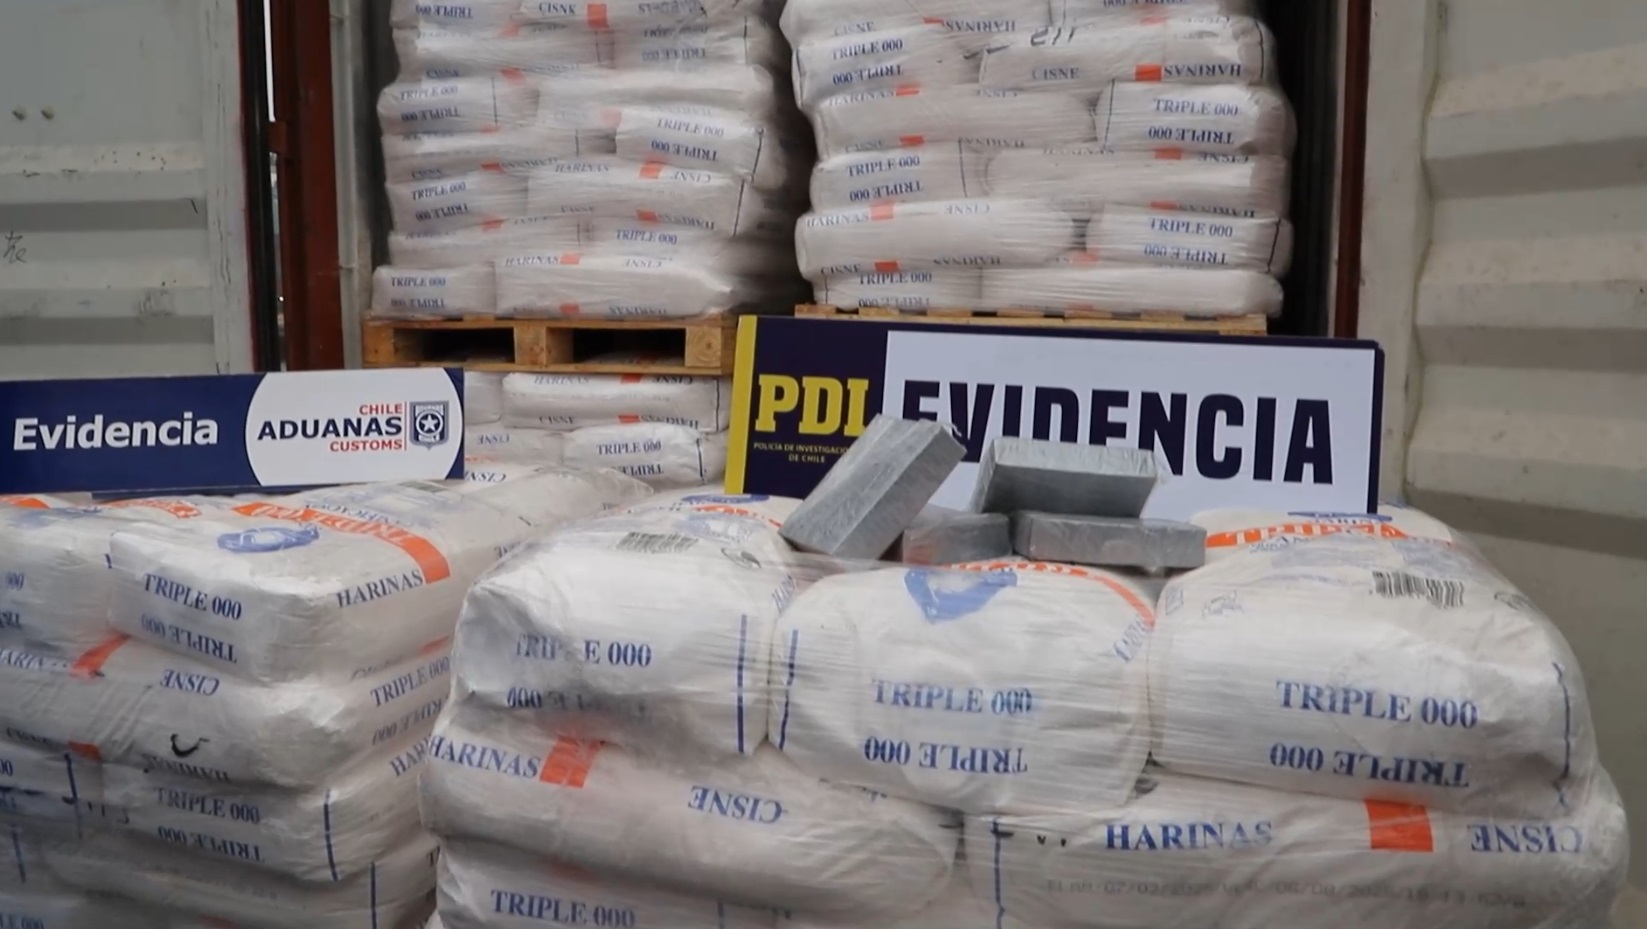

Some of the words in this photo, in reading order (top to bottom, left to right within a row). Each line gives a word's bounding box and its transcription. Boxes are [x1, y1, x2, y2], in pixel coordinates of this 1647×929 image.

[832, 43, 880, 60] TRIPLE
[882, 39, 903, 51] 000
[832, 74, 853, 86] 000
[856, 64, 905, 82] TRIPLE
[1164, 64, 1241, 77] HARINAS
[1153, 99, 1210, 114] TRIPLE
[1214, 102, 1239, 116] 000
[657, 117, 701, 134] TRIPLE
[703, 126, 725, 138] 000
[1149, 127, 1173, 140] 000
[1175, 128, 1235, 145] TRIPLE
[651, 140, 670, 154] 000
[672, 144, 719, 162] TRIPLE
[846, 159, 895, 177] TRIPLE
[899, 155, 920, 168] 000
[411, 187, 448, 201] TRIPLE
[848, 189, 870, 201] 000
[872, 180, 923, 199] TRIPLE
[616, 228, 656, 243] TRIPLE
[658, 233, 678, 245] 000
[1149, 217, 1206, 235] TRIPLE
[1208, 223, 1234, 239] 000
[1143, 244, 1167, 257] 000
[1170, 250, 1229, 266] TRIPLE
[391, 276, 427, 288] TRIPLE
[428, 277, 446, 288] 000
[858, 272, 909, 286] TRIPLE
[911, 270, 932, 284] 000
[359, 403, 403, 416] CHILE
[755, 374, 869, 437] PDI
[13, 411, 219, 450] Evidencia
[257, 416, 403, 441] ADUANAS
[329, 439, 403, 452] CUSTOMS
[596, 443, 642, 456] TRIPLE
[784, 444, 795, 452] DE
[788, 454, 799, 462] DE
[802, 455, 826, 463] CHILE
[464, 470, 507, 483] CISN
[143, 573, 208, 612] TRIPLE
[212, 596, 242, 621] 000
[335, 569, 425, 608] HARINAS
[140, 612, 166, 635] 000
[168, 623, 238, 664] TRIPLE
[606, 640, 653, 668] 000
[160, 668, 220, 697] CISNE
[369, 668, 428, 708] TRIPLE
[428, 656, 451, 680] 000
[506, 686, 543, 710] 000
[871, 678, 984, 713] TRIPLE
[990, 686, 1034, 716] 000
[1275, 680, 1412, 722] TRIPLE
[1420, 696, 1479, 729] 000
[371, 722, 399, 746] 000
[429, 734, 543, 779] HARINAS
[863, 735, 912, 766] 000
[918, 742, 1028, 774] TRIPLE
[1269, 742, 1324, 772] 000
[1332, 749, 1470, 789] TRIPLE
[154, 786, 226, 818] TRIPLE
[229, 805, 261, 826] 000
[687, 784, 784, 825] CISNE
[157, 825, 188, 846] 000
[1104, 820, 1273, 851] HARINAS
[1467, 824, 1583, 854] CISNE
[190, 832, 266, 864] TRIPLE
[489, 889, 588, 926] TRIPLE
[592, 904, 636, 929] 000
